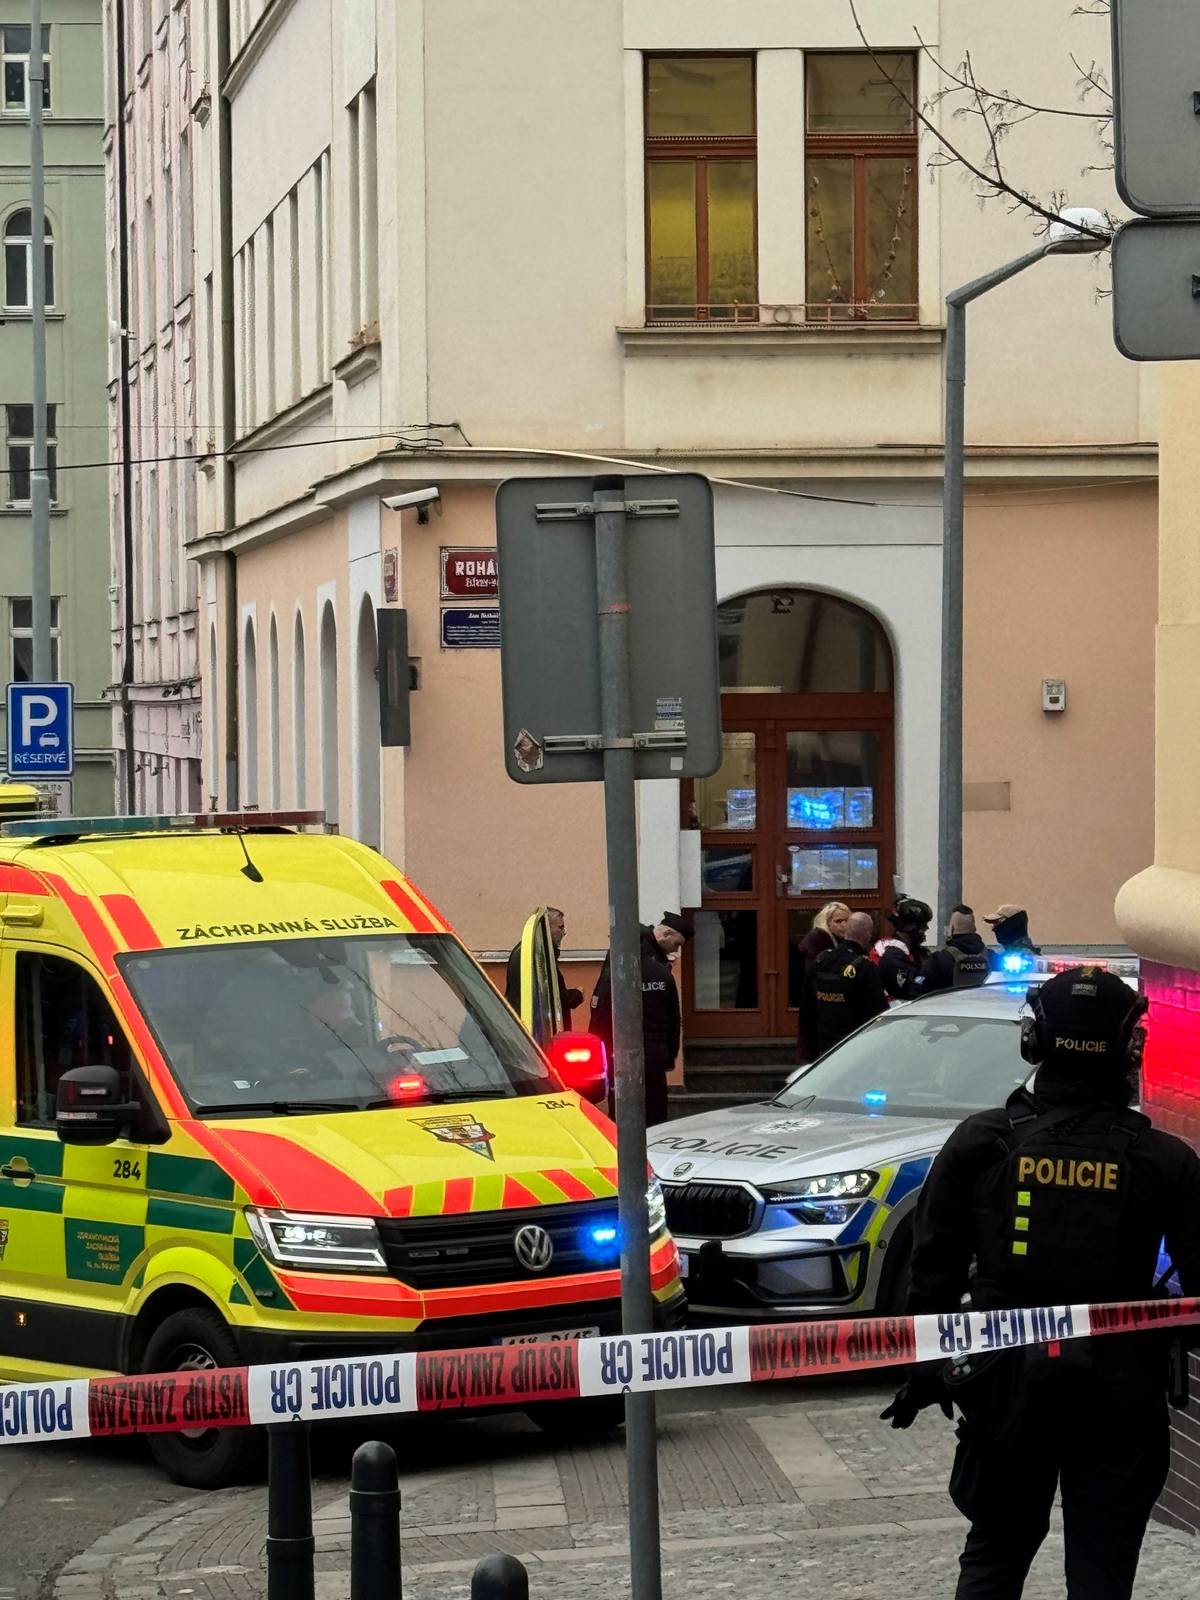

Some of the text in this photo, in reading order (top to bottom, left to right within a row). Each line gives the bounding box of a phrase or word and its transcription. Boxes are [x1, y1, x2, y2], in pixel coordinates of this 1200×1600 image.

[455, 558, 497, 576] ROHÁ
[21, 695, 58, 746] P
[176, 914, 399, 941] ZÁCHRANNÁ SLUŽBA
[1055, 1036, 1107, 1053] POLICIE
[537, 1099, 575, 1110] 284
[647, 1136, 799, 1159] POLICIE
[113, 1159, 142, 1180] 284
[1018, 1156, 1119, 1191] POLICIE
[511, 1345, 576, 1393] VSTUP
[641, 1331, 734, 1382] POLICIE
[182, 1373, 246, 1422] VSTUP
[311, 1359, 401, 1411] POLICIE
[0, 1386, 74, 1437] POLICI
